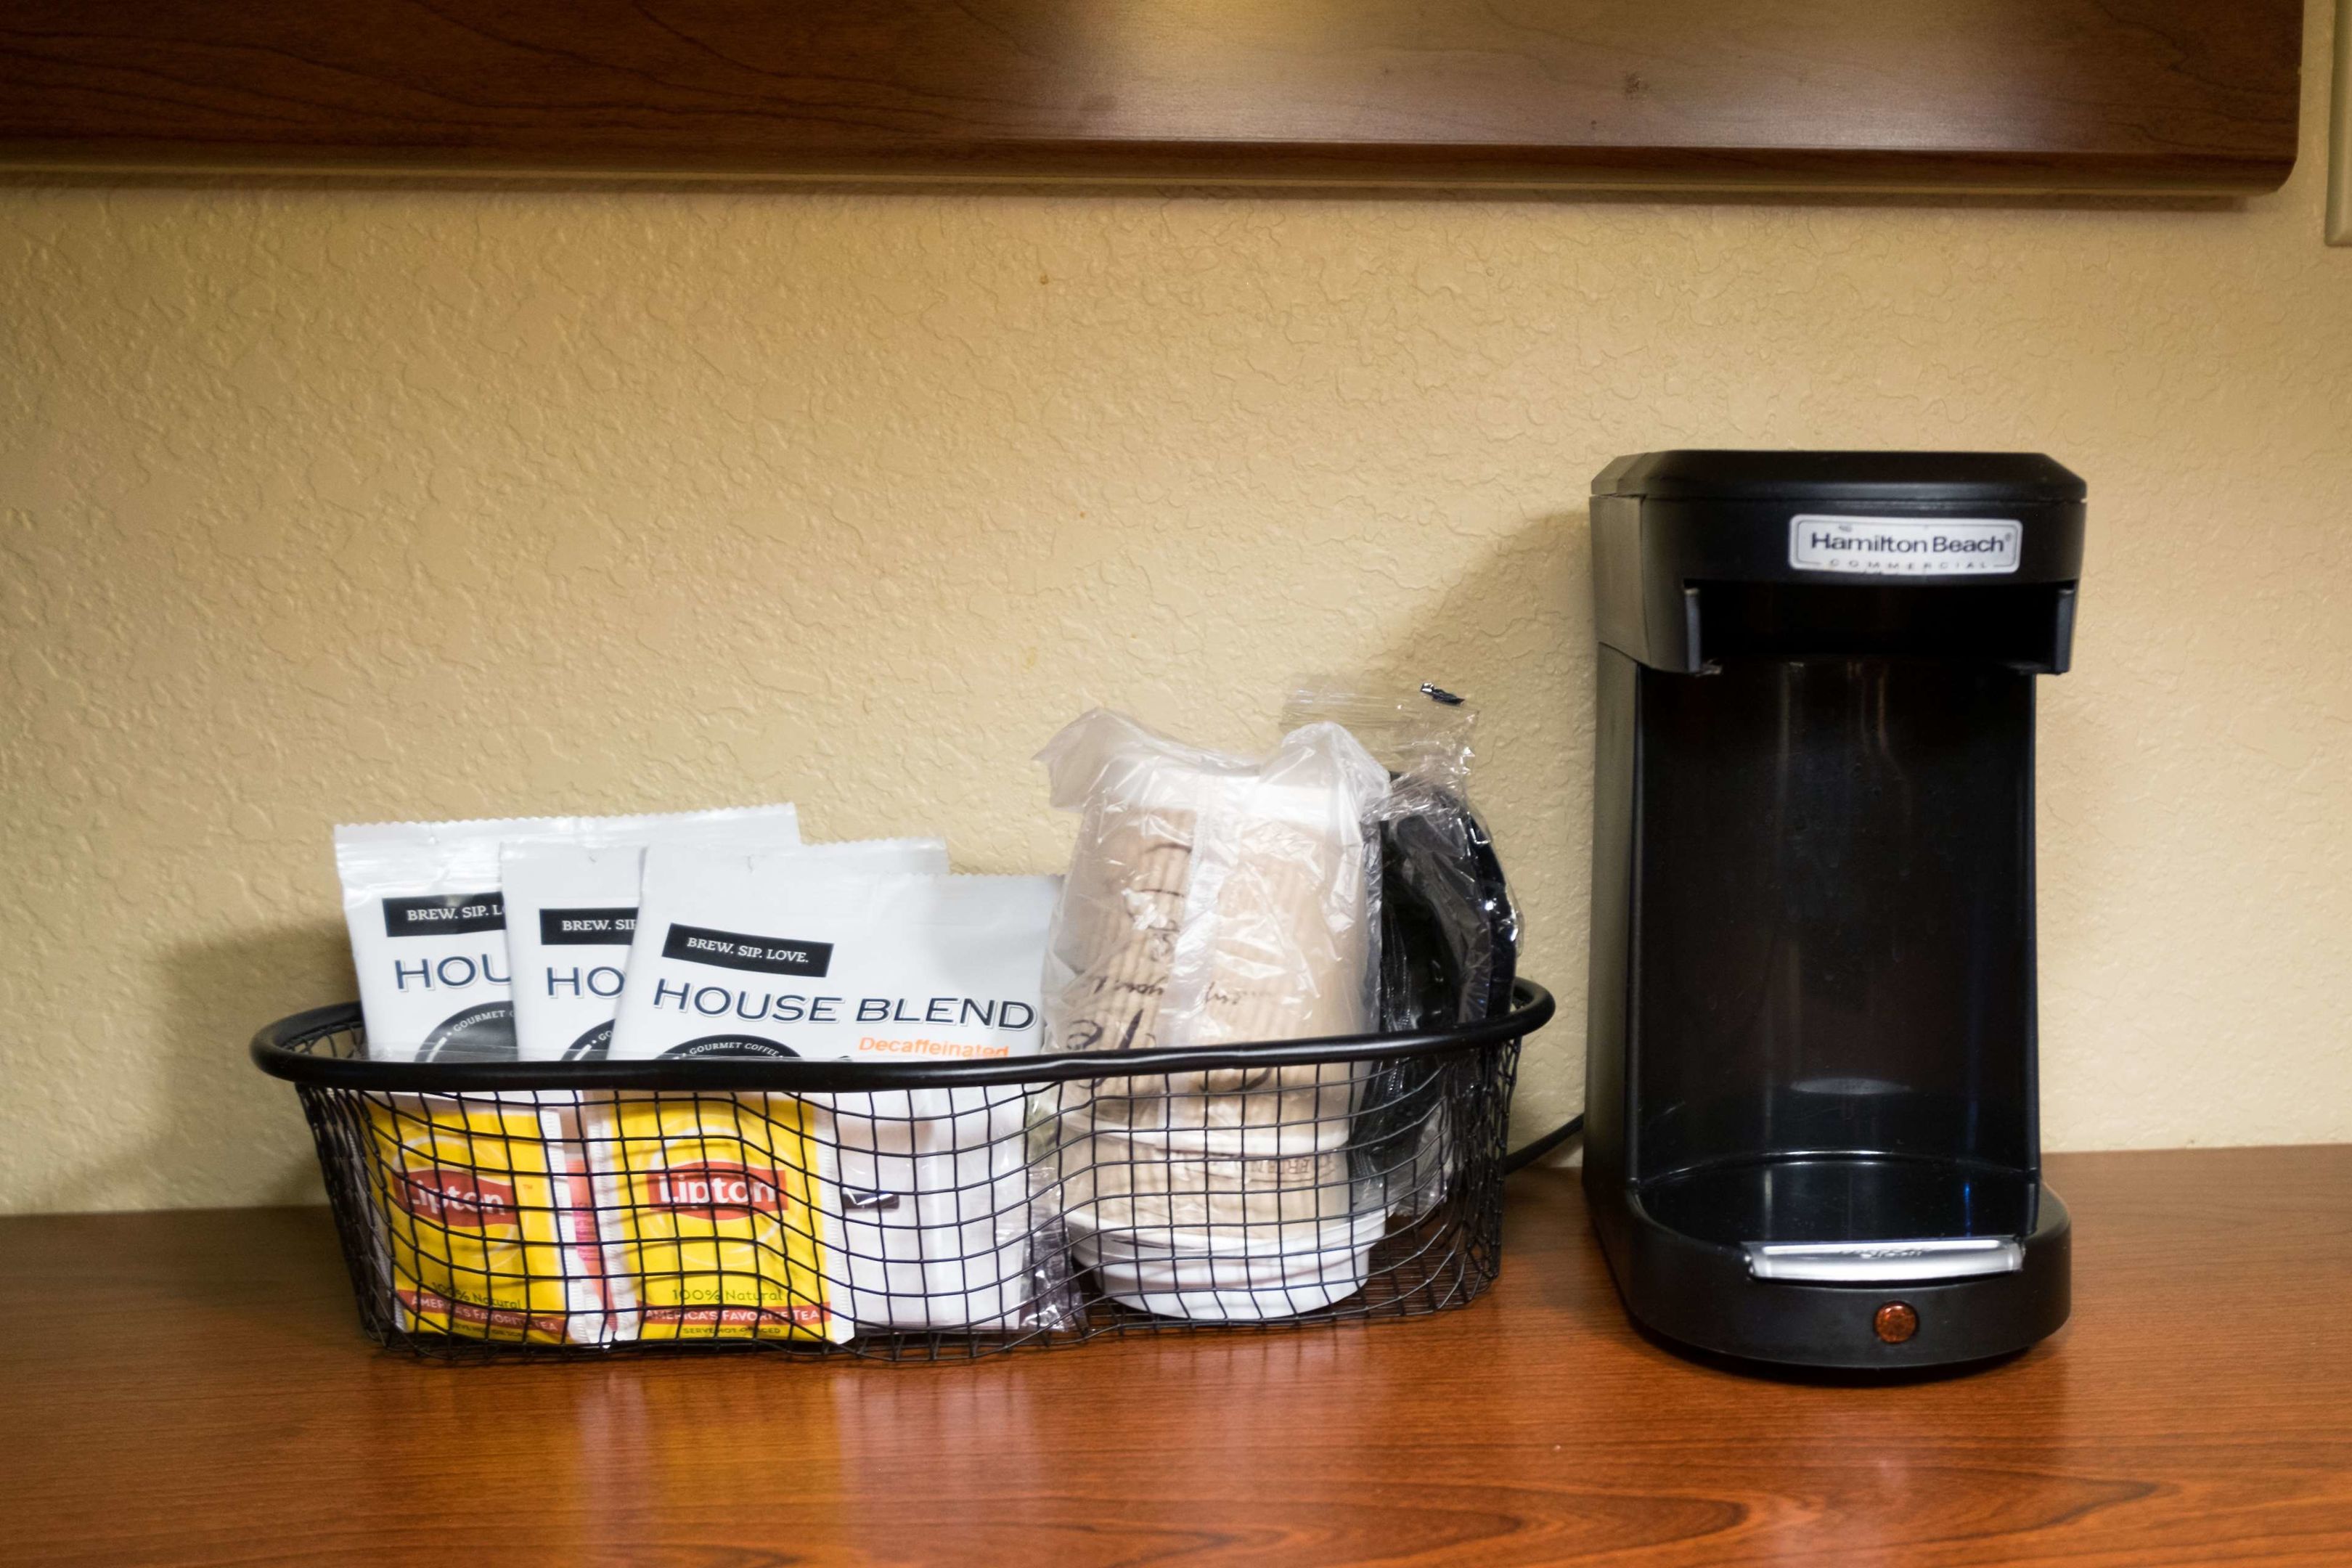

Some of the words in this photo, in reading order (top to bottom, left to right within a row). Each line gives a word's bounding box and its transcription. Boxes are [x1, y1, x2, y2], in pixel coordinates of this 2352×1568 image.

[1812, 532, 1927, 552] Hamilton
[1933, 535, 2004, 552] Beach
[407, 908, 459, 921] BREW.
[462, 905, 489, 918] SIP.
[562, 920, 612, 931] BREW.
[687, 936, 734, 955] BREW.
[738, 944, 763, 958] SIP.
[766, 949, 809, 963] LOVE.
[394, 953, 511, 991] HOU
[547, 966, 626, 997] HO
[653, 978, 844, 1022] HOUSE
[855, 997, 1037, 1031] BLEND
[453, 1010, 506, 1032] GOURMET
[689, 1042, 742, 1055] GOURMET
[744, 1042, 780, 1057] COFFEE
[859, 1037, 1009, 1058] Decaffeinated
[402, 1179, 506, 1215] Lipton
[658, 1175, 775, 1210] Lipton
[473, 1291, 521, 1310] Natural
[672, 1289, 720, 1301] 100%
[726, 1289, 783, 1301] Natural
[473, 1309, 529, 1327] FAVORIT
[722, 1310, 788, 1321] FAVORIE
[793, 1310, 820, 1321] TEA
